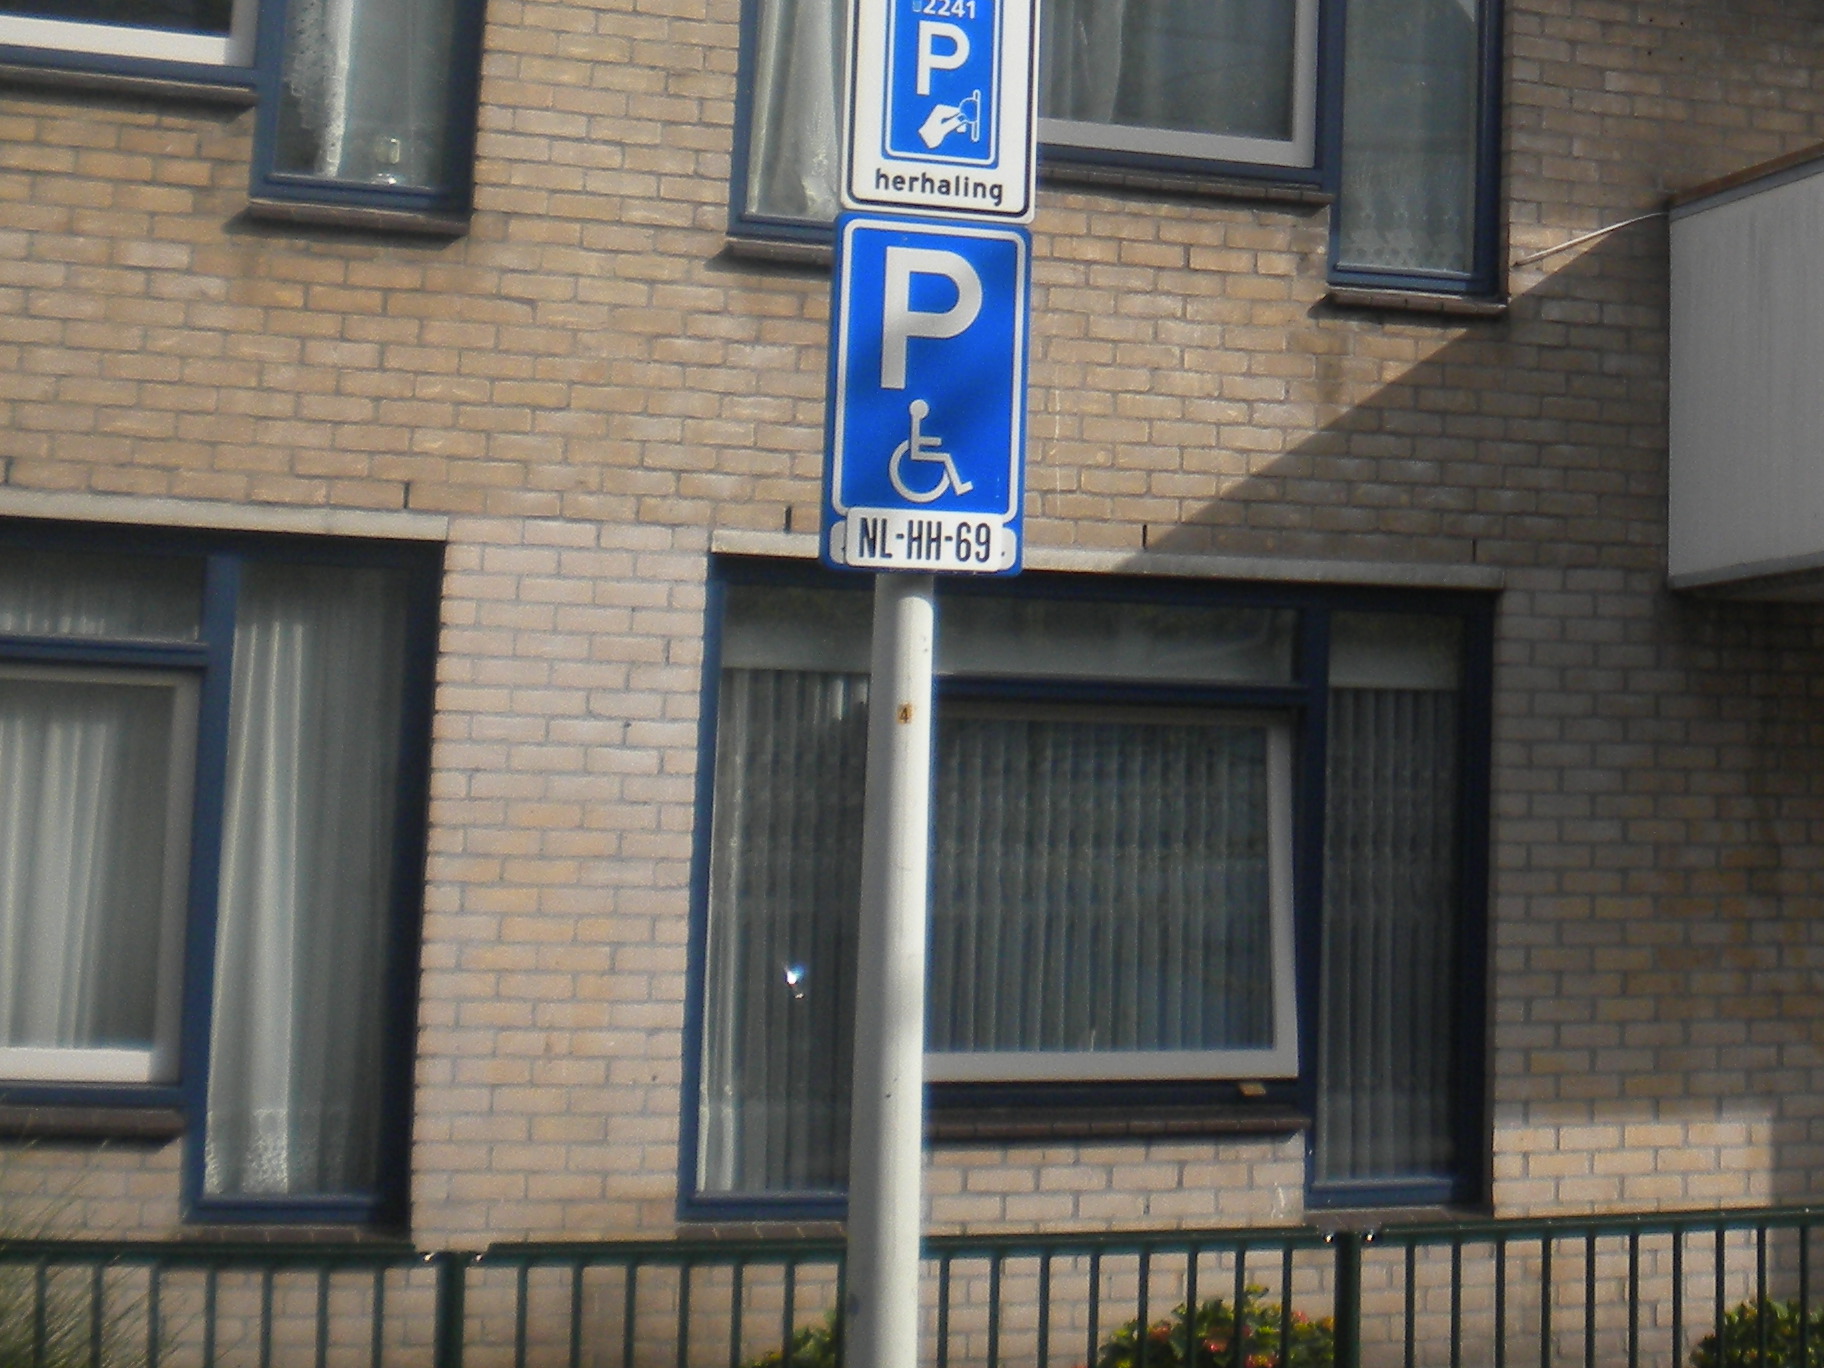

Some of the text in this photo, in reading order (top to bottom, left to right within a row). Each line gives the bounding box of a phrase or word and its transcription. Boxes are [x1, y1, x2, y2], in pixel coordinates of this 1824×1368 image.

[916, 21, 970, 96] P
[875, 169, 1003, 206] herhaling
[881, 246, 983, 390] P
[859, 516, 991, 563] NL-HH-69
